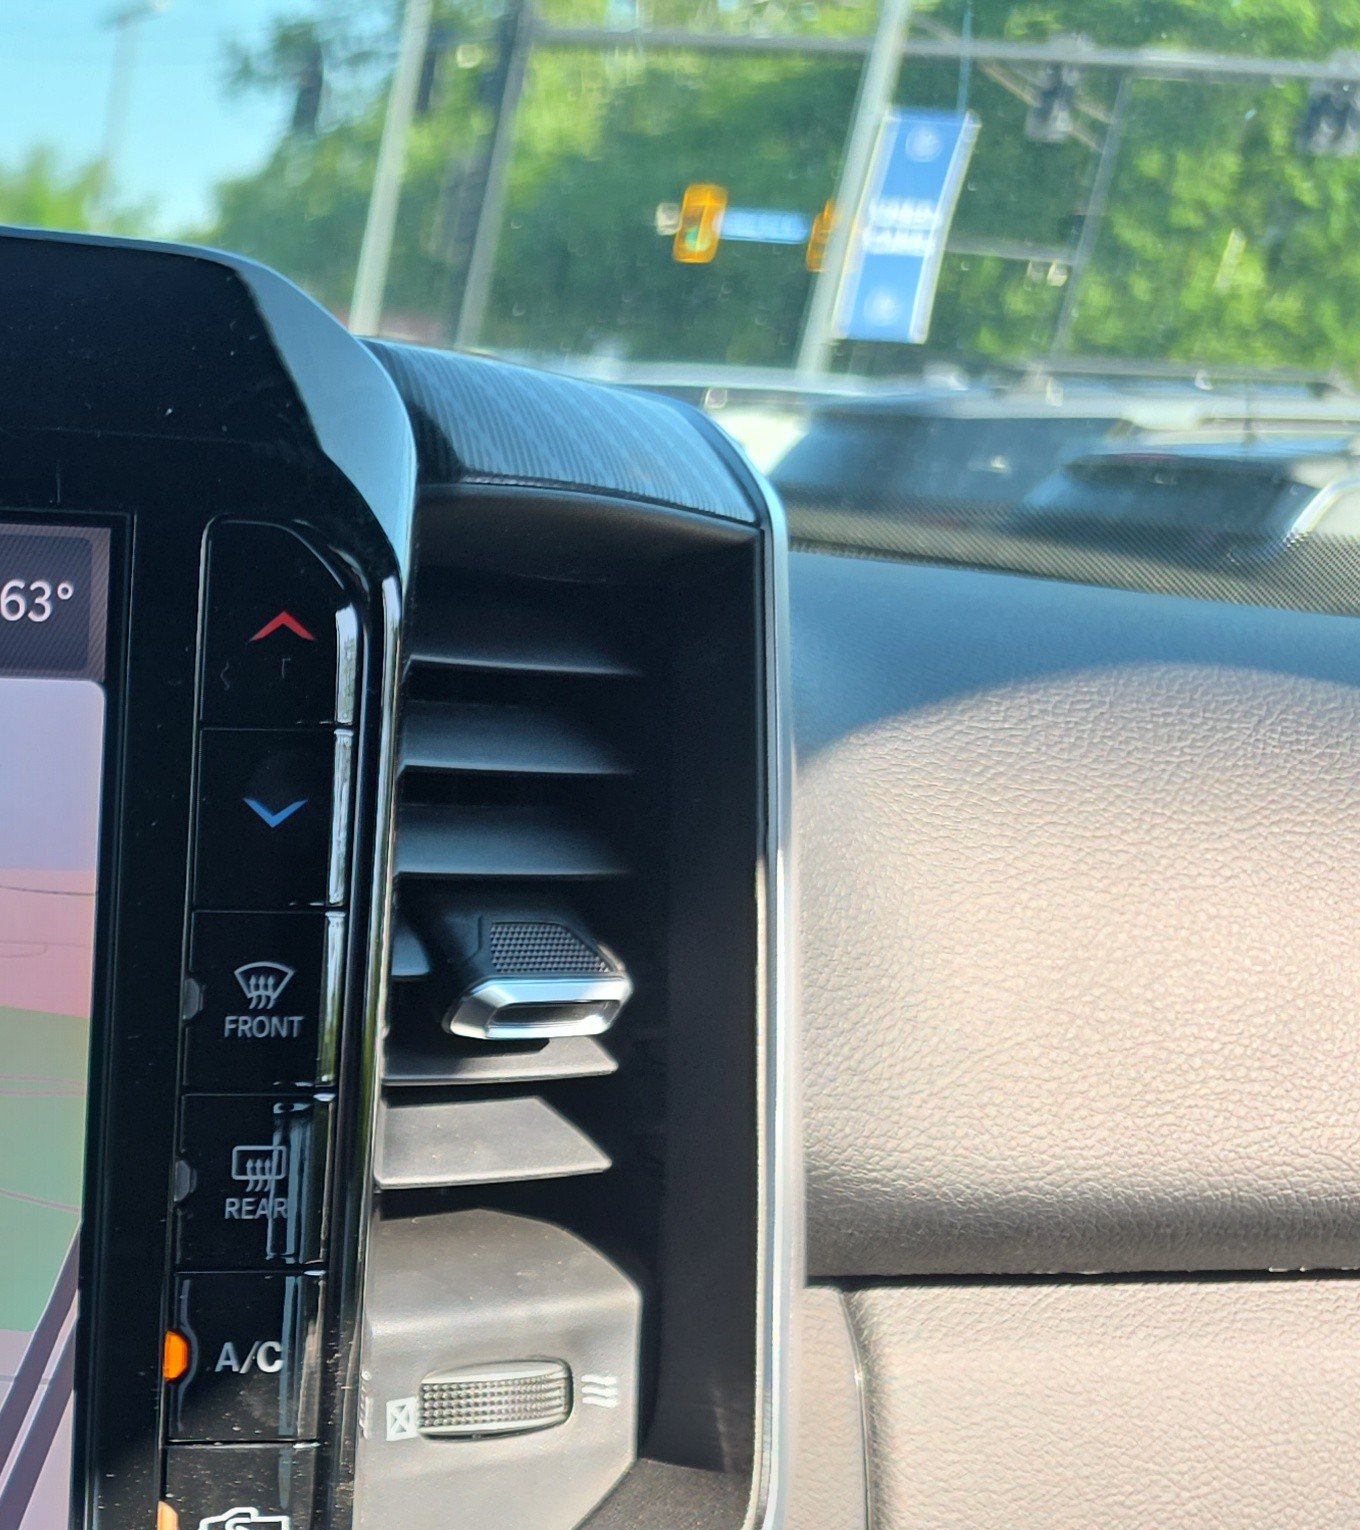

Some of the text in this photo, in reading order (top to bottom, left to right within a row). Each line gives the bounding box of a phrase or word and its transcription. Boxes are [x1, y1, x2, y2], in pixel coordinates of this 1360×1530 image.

[223, 1015, 303, 1038] FRONT
[224, 1197, 289, 1220] REAR
[214, 1339, 284, 1374] A/C
